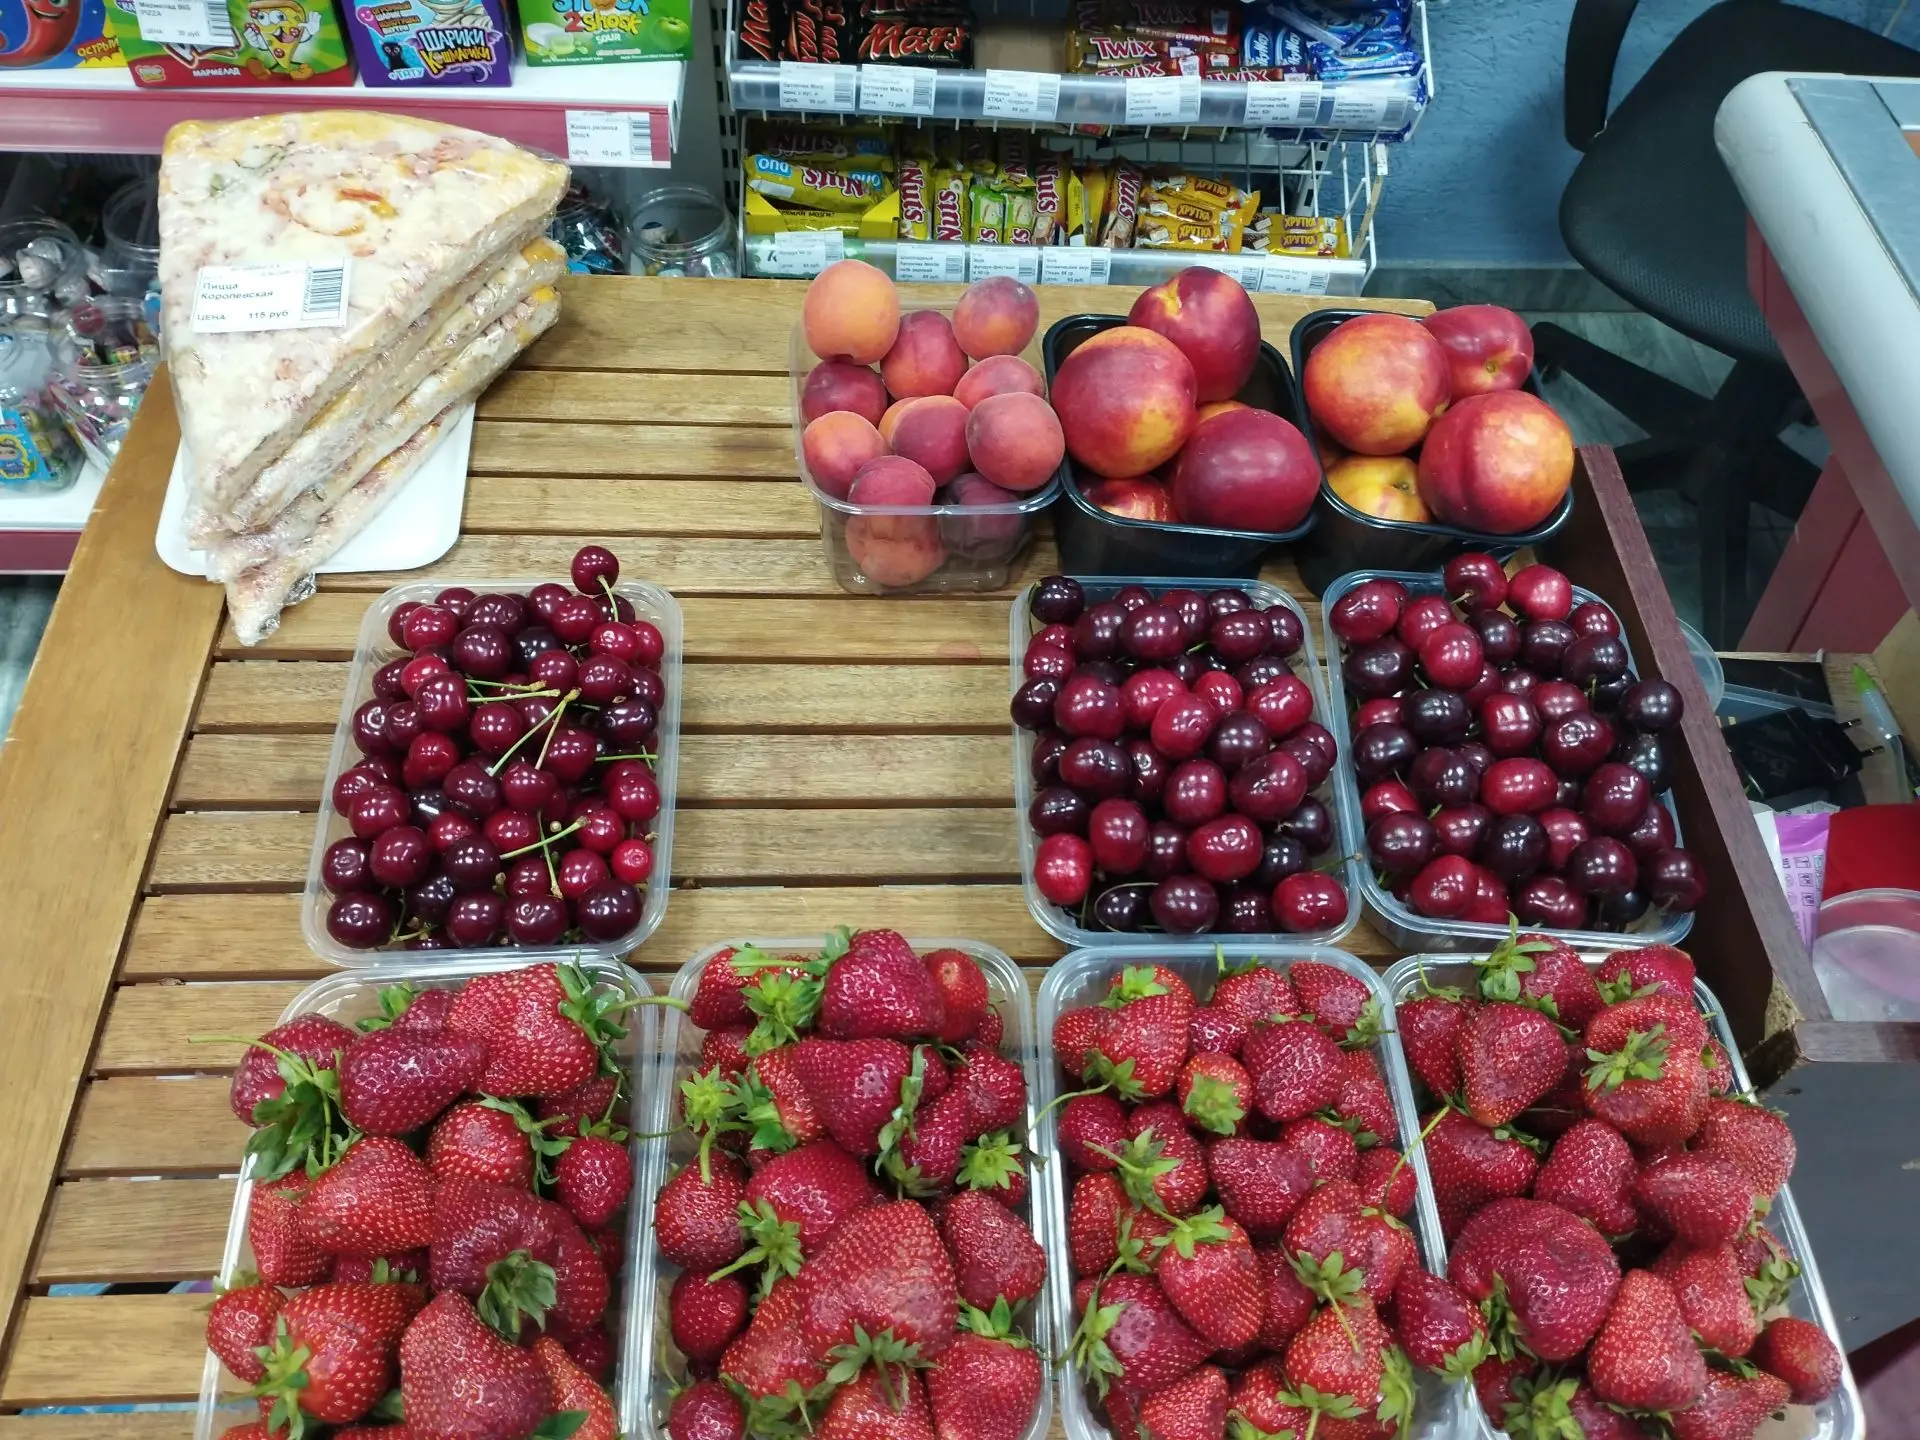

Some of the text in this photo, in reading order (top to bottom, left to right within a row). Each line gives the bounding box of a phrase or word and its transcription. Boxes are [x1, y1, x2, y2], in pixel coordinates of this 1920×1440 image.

[418, 28, 485, 51] ШАРИКИ
[596, 34, 621, 44] SOUR
[192, 67, 241, 77] МАРМЕЛАД
[802, 167, 865, 198] Nuts
[1195, 179, 1229, 197] ХРУТКА
[899, 167, 925, 223] Nuts
[935, 188, 963, 242] Nuts
[1178, 204, 1212, 221] ХРУТКА
[1284, 215, 1317, 229] ХРУТКА
[1178, 224, 1212, 241] ХРУТКА
[1282, 234, 1317, 247] ХРУТКА
[203, 282, 238, 291] Пицца
[201, 291, 273, 300] Королевская
[269, 310, 289, 319] руб
